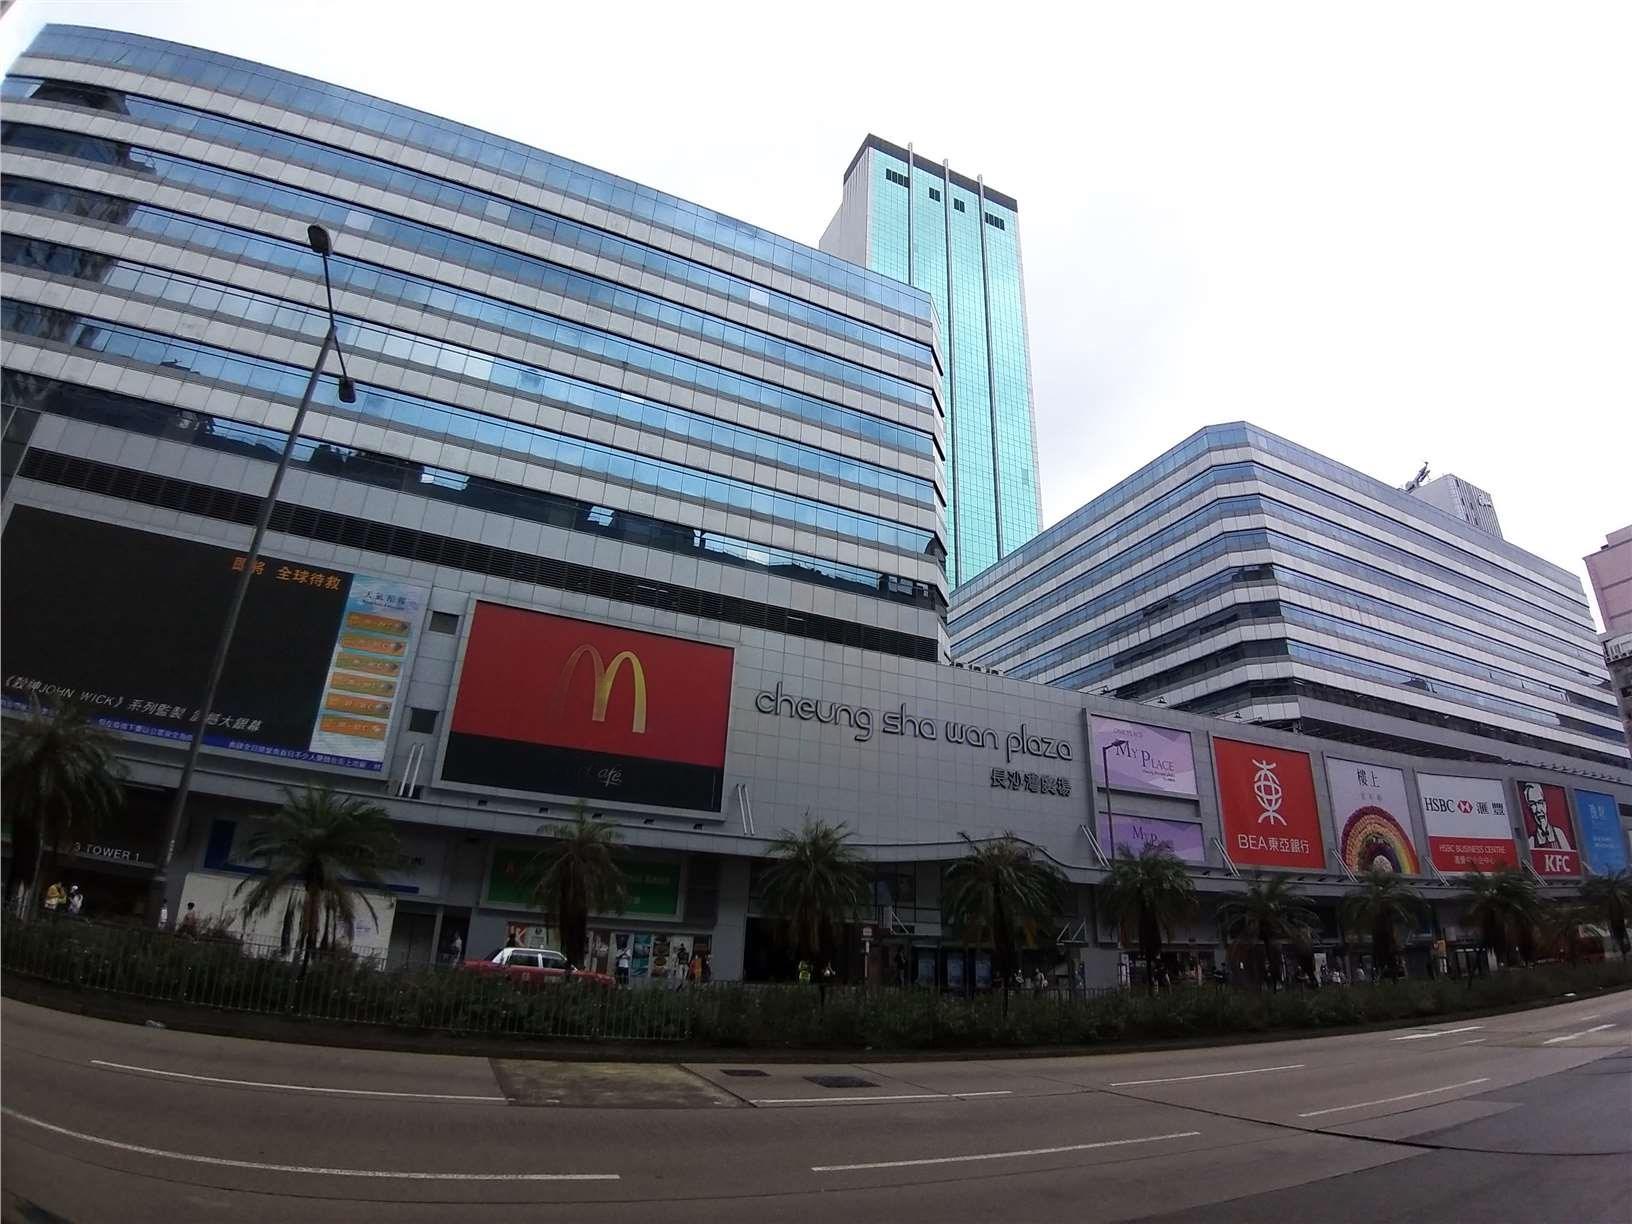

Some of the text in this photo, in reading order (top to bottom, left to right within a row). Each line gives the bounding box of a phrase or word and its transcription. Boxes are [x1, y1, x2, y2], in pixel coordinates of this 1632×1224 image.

[755, 681, 1074, 764] cheung sha wan plaza
[1141, 750, 1176, 773] PLACE
[1356, 767, 1380, 788] 樓上
[1423, 797, 1456, 813] HSBC
[85, 843, 131, 861] TOWER
[1237, 834, 1312, 855] BEA 東亞銀行
[1544, 854, 1571, 872] KFC
